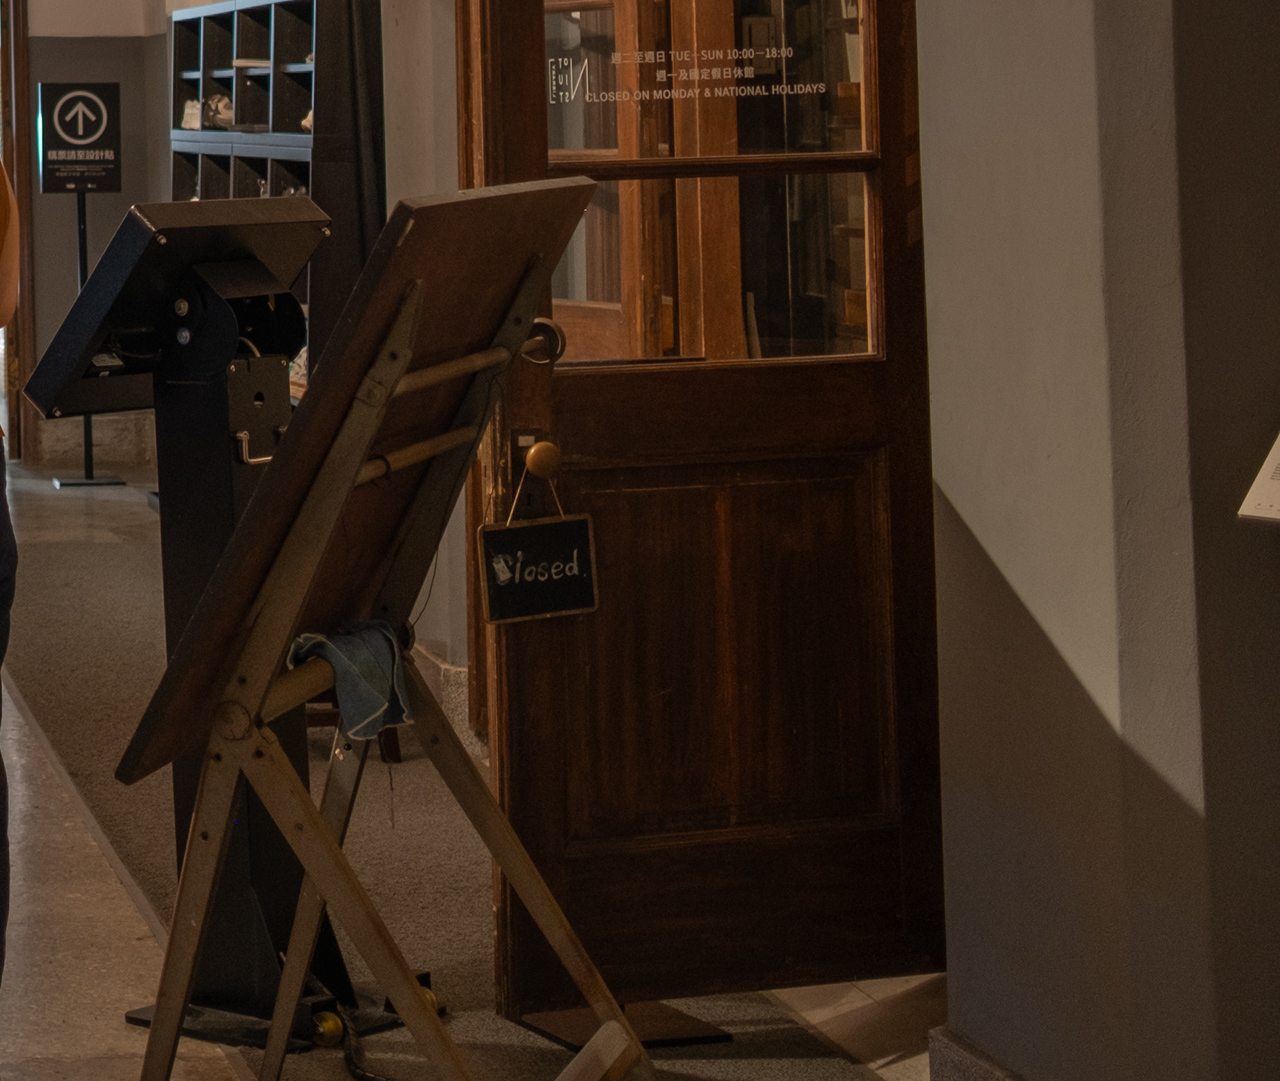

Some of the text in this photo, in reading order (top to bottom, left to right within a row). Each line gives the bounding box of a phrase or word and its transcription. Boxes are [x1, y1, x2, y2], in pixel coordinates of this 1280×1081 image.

[611, 51, 666, 65] 週二至週日
[655, 67, 755, 82] 週一及國定假日休館
[585, 83, 826, 103] CLOSED ON MONDAY & NATIONAL HOLIDAYS
